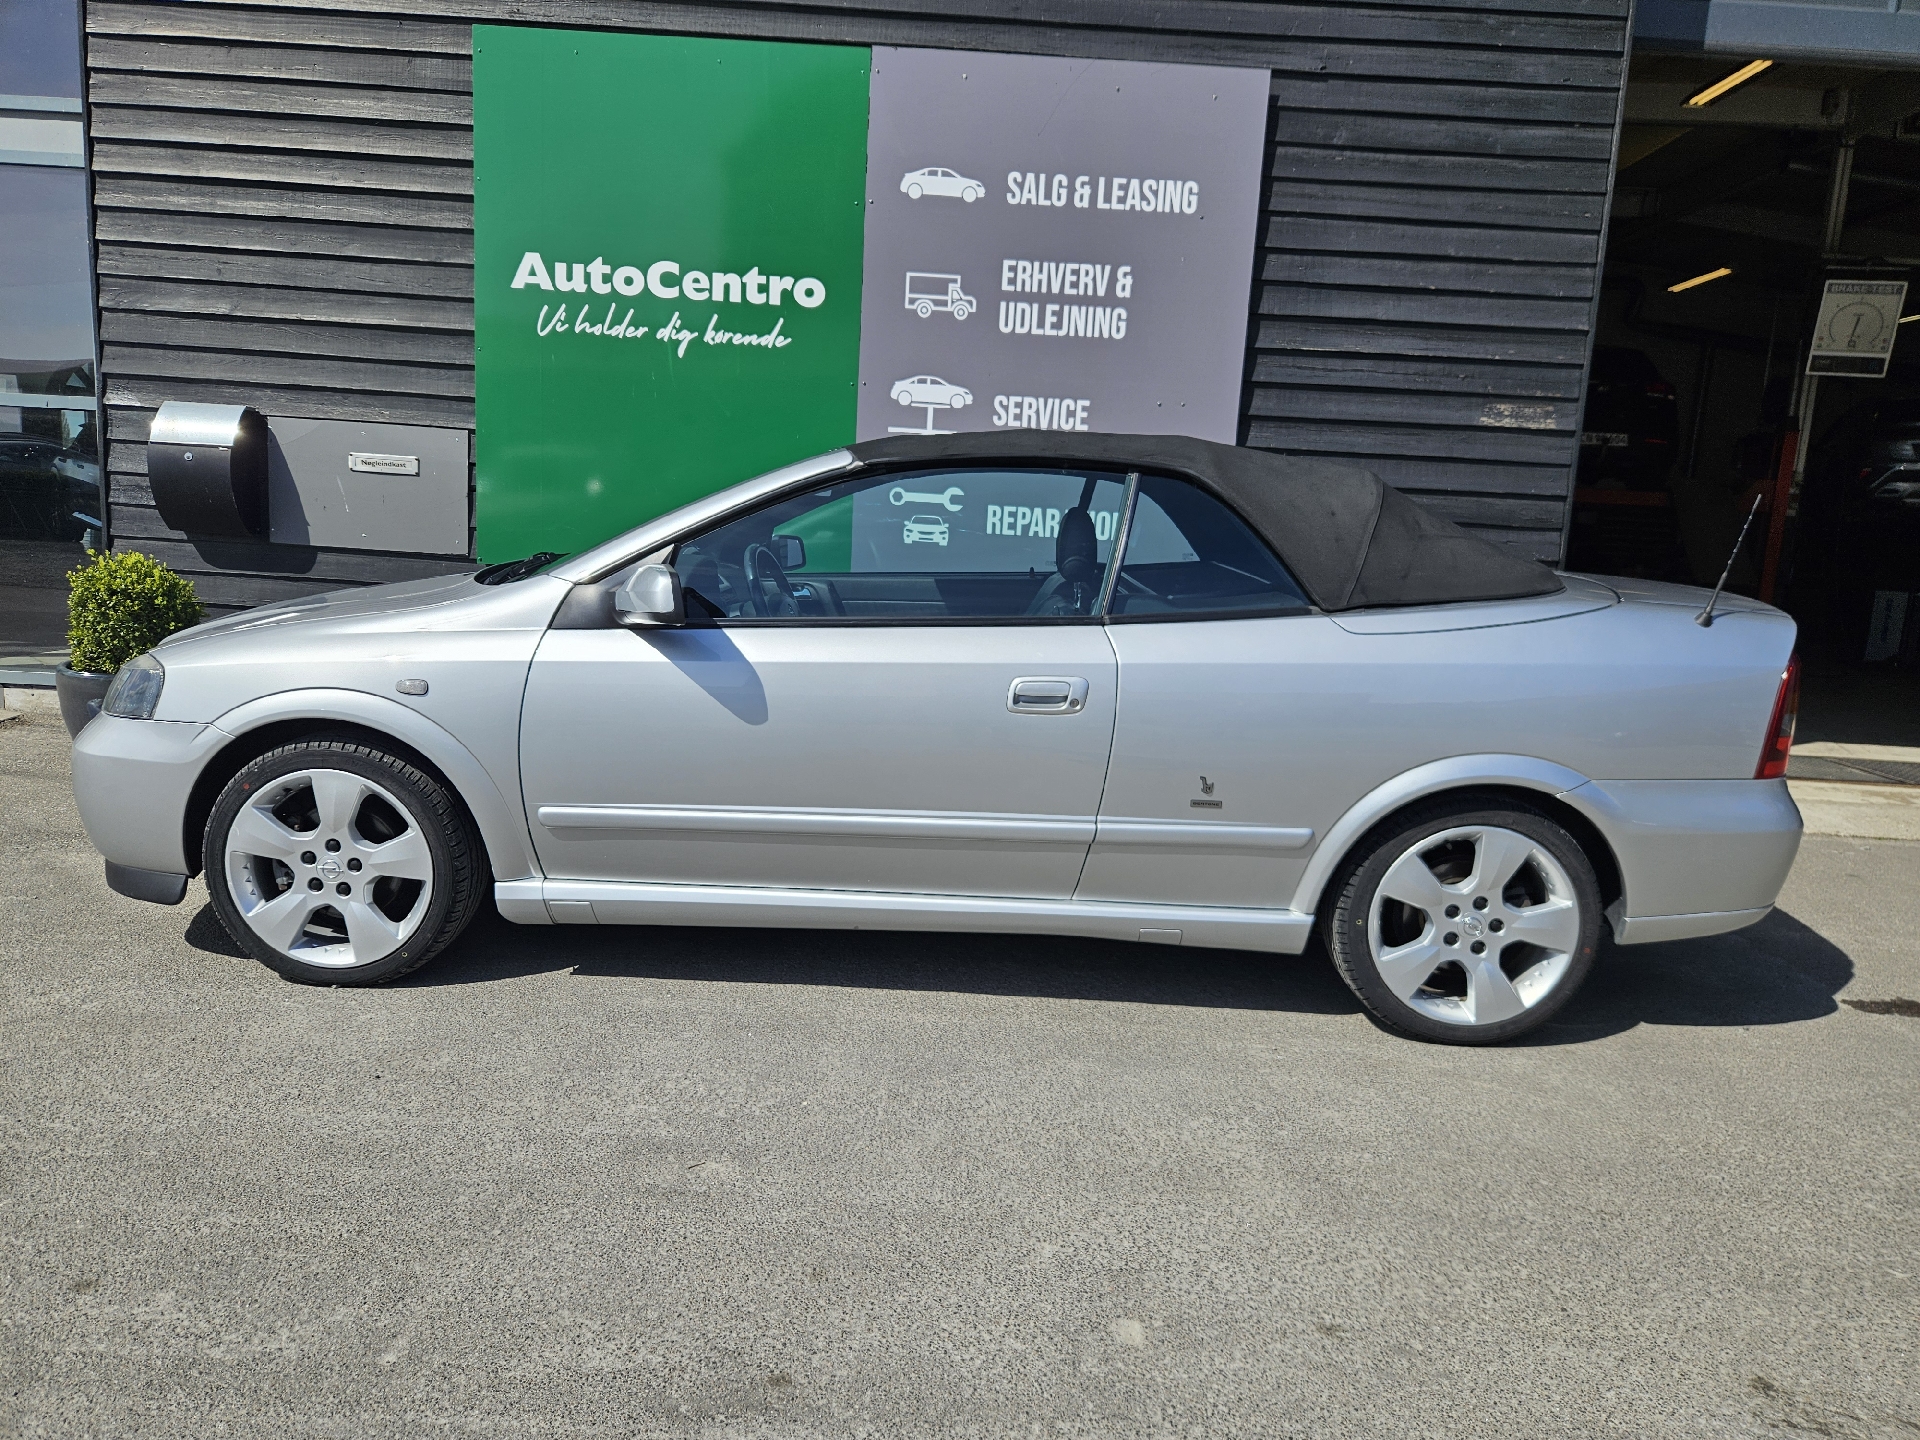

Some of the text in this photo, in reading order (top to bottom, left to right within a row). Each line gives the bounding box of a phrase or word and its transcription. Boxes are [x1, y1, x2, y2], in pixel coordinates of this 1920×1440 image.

[1006, 171, 1199, 214] SALG & LEASING
[510, 251, 826, 308] AutoCentro
[1001, 259, 1133, 298] ERHVERV &
[537, 303, 569, 337] Vi
[574, 302, 649, 339] holder
[655, 311, 699, 359] dig
[999, 301, 1127, 340] UDLEJNING
[992, 395, 1090, 431] SERVICE
[361, 459, 407, 468] Nøgleindkast
